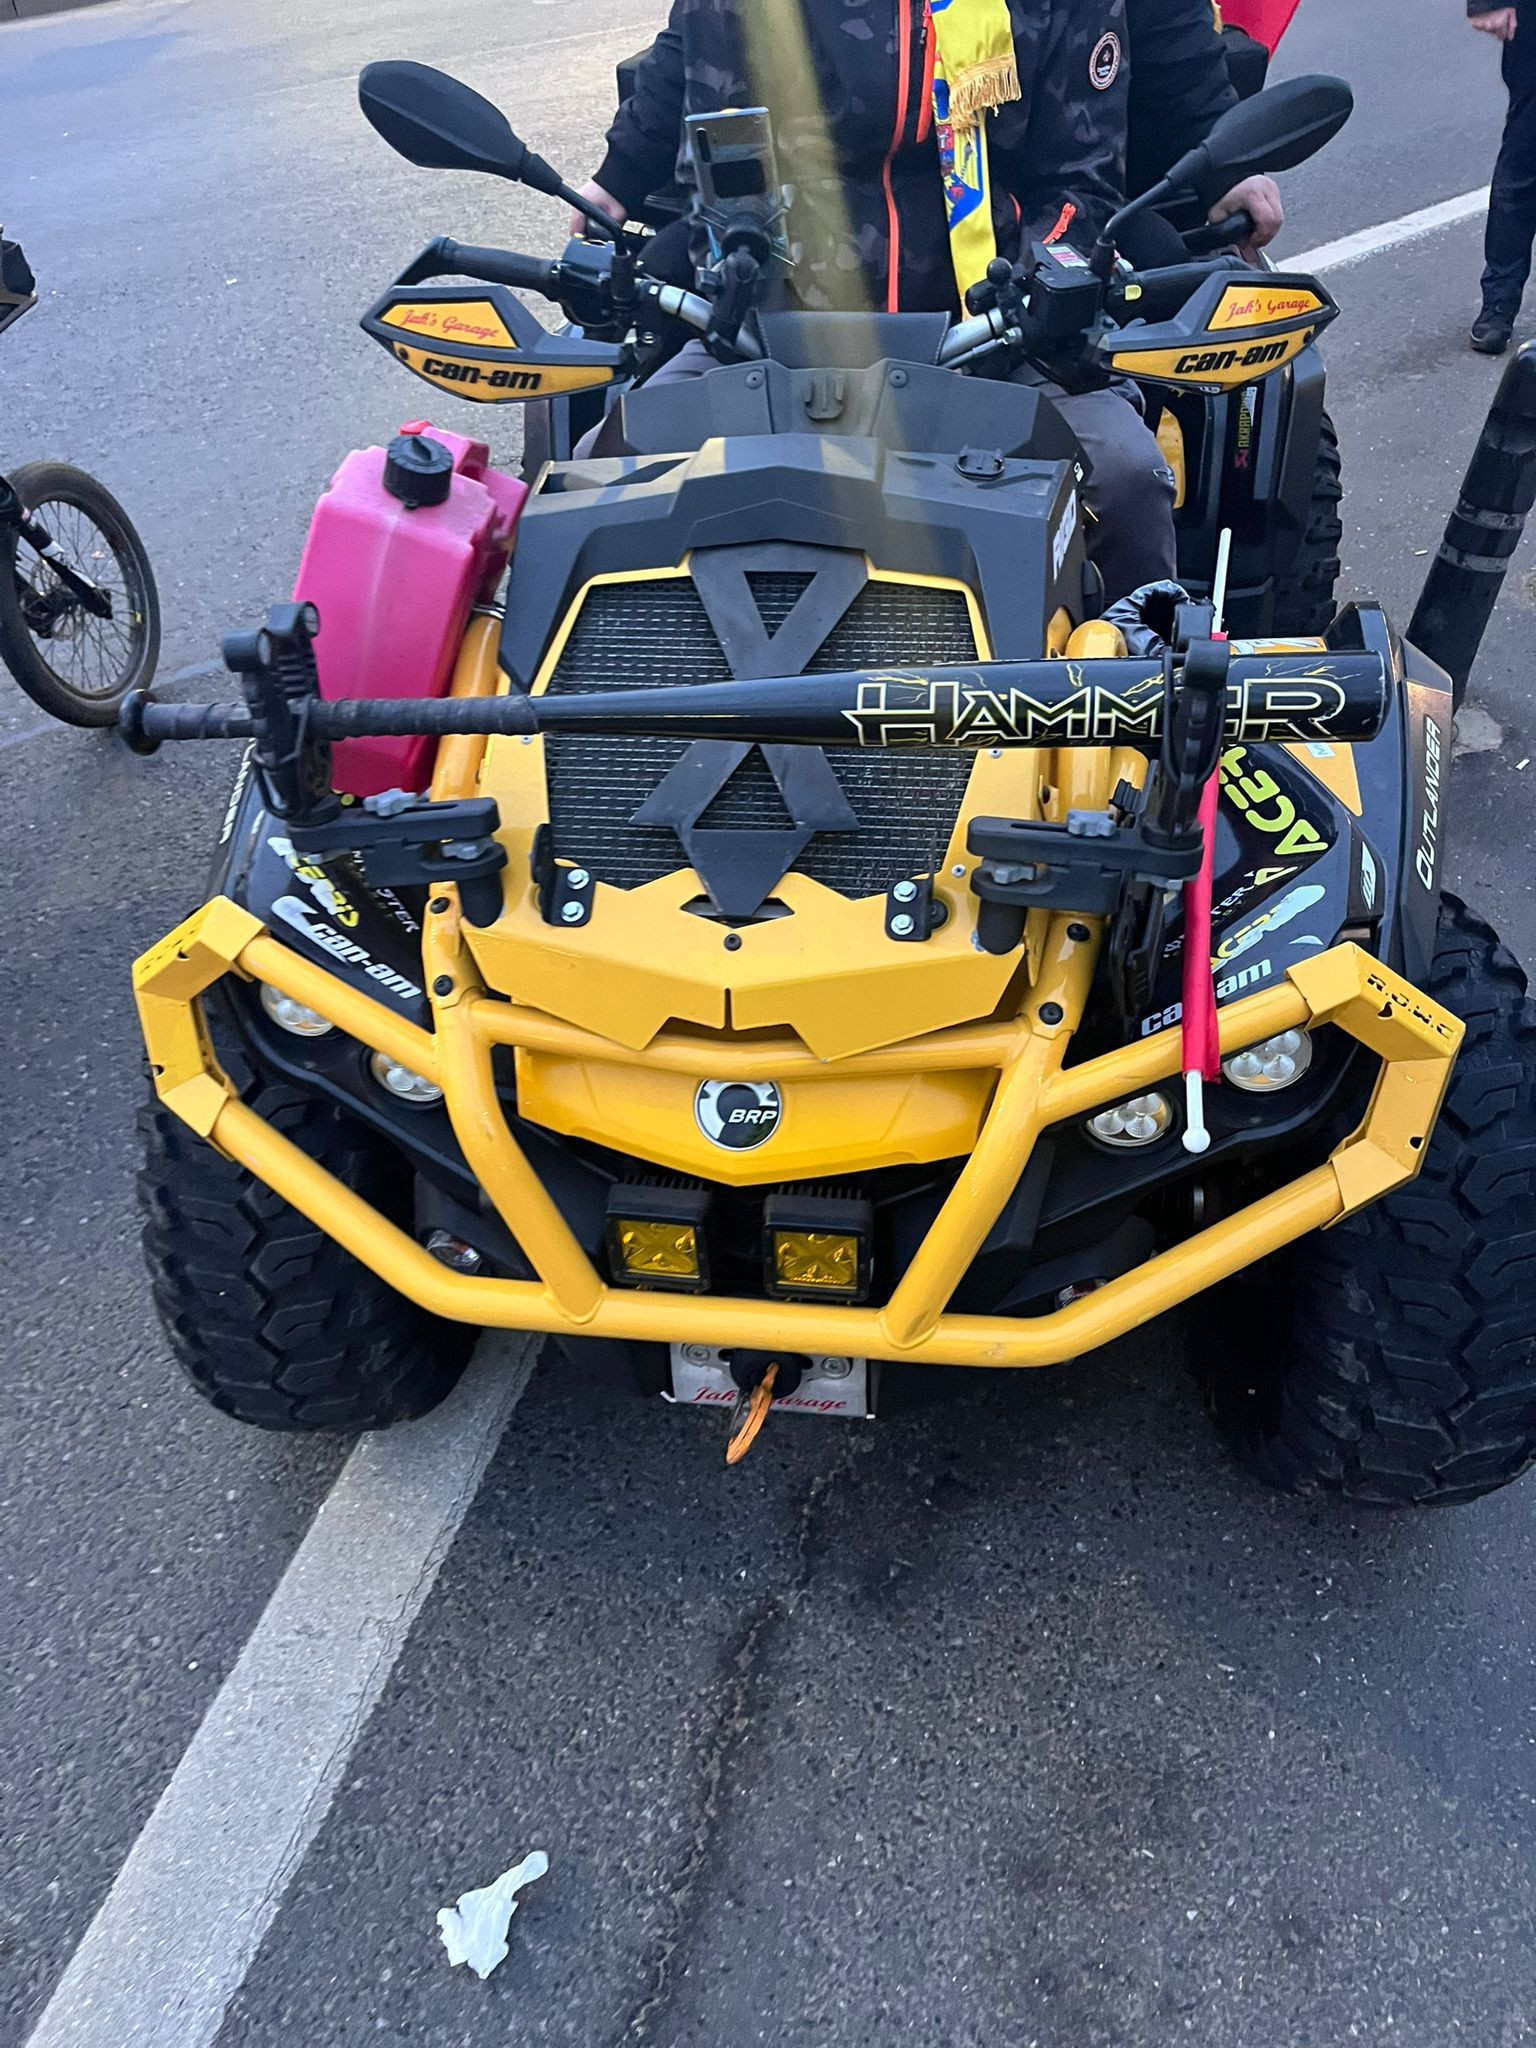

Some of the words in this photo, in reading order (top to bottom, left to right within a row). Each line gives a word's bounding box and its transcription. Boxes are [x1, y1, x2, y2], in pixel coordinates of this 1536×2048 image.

[1225, 298, 1261, 322] Jak's
[1267, 298, 1310, 316] Garage
[442, 316, 498, 339] Garage
[422, 357, 542, 390] can-am
[1174, 340, 1289, 374] can-am
[1415, 715, 1442, 891] OUTLANDER
[309, 922, 422, 999] can-am
[1141, 959, 1272, 1036] caam
[728, 1108, 778, 1124] BRP
[692, 1386, 737, 1402] Jak
[773, 1397, 848, 1410] arage
